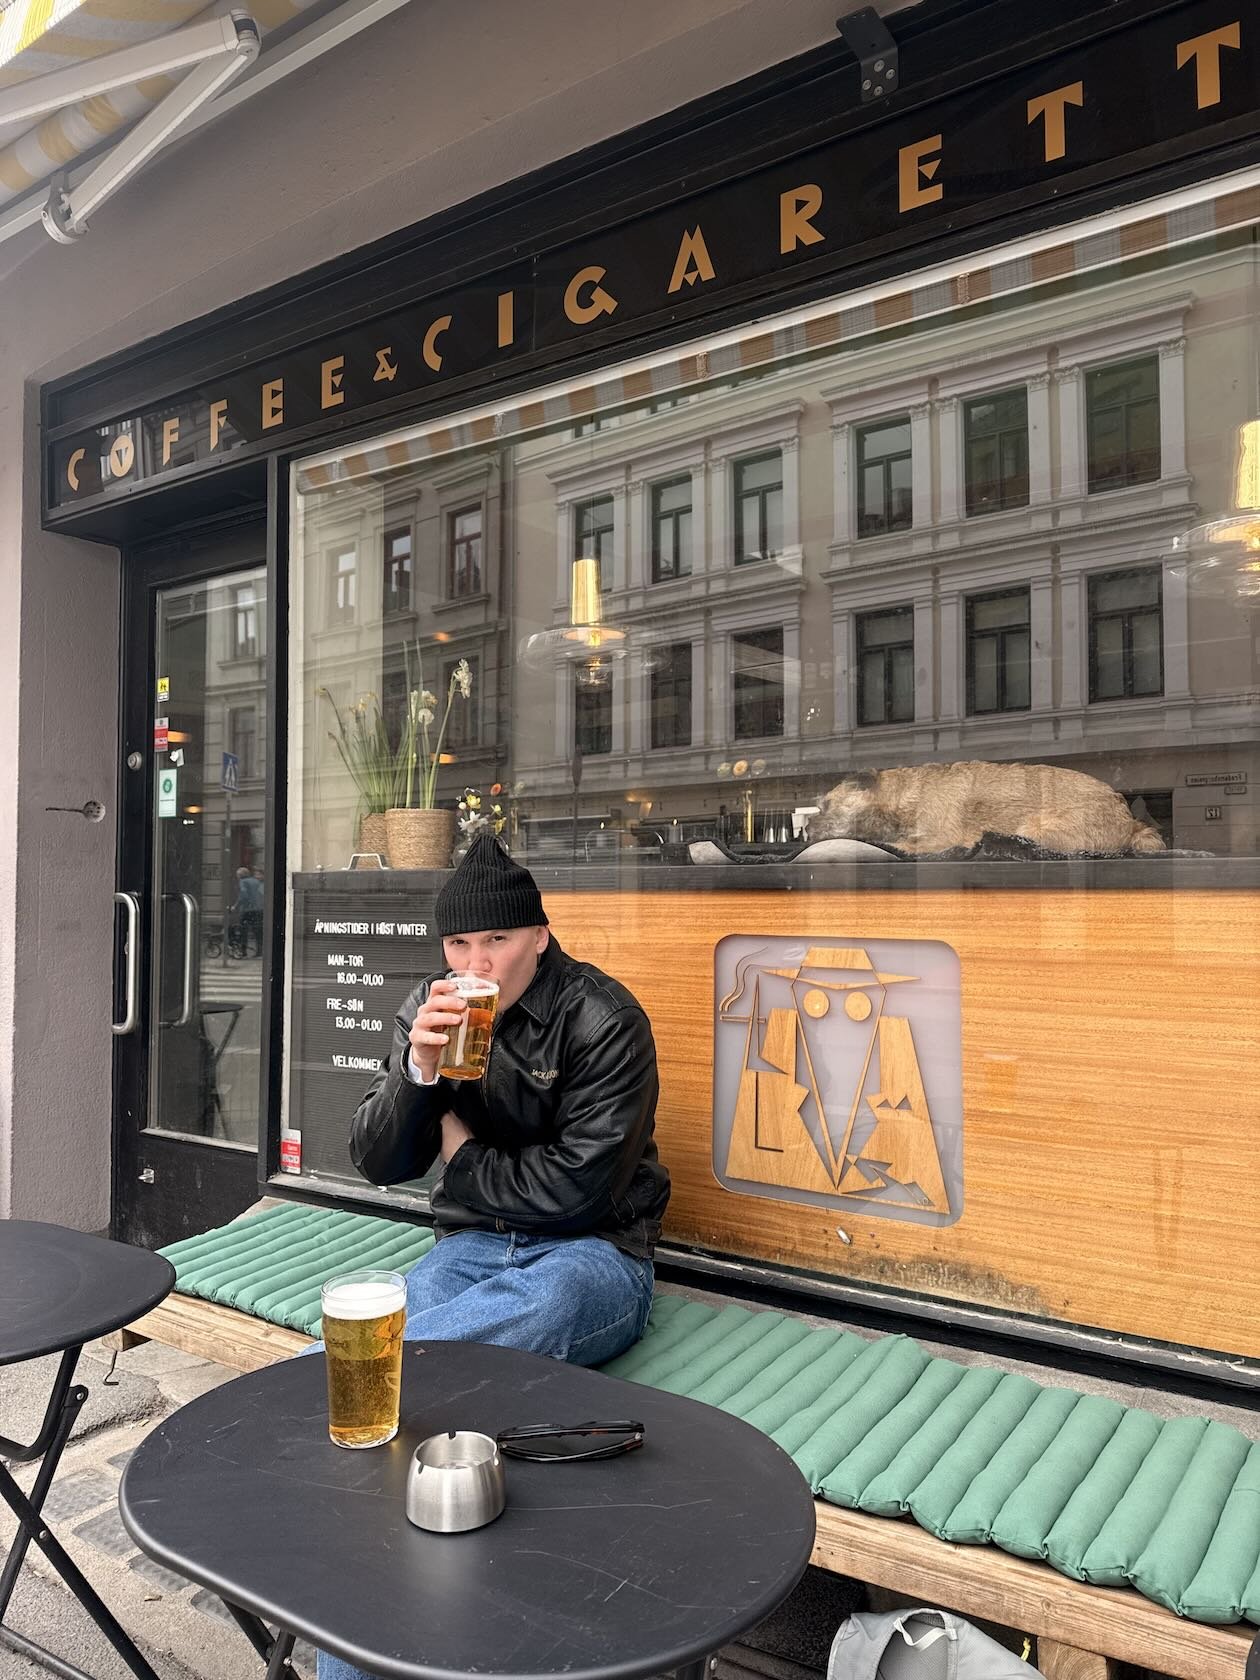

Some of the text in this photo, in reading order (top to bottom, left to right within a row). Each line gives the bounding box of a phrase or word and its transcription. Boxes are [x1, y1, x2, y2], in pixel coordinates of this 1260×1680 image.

[67, 21, 1241, 491] COFFEE & CIGARETT
[314, 918, 428, 936] ÅPNINGSTIDER I HØST VINTER
[327, 954, 364, 967] MAN-TOR
[326, 997, 364, 1013] FRE-SØN
